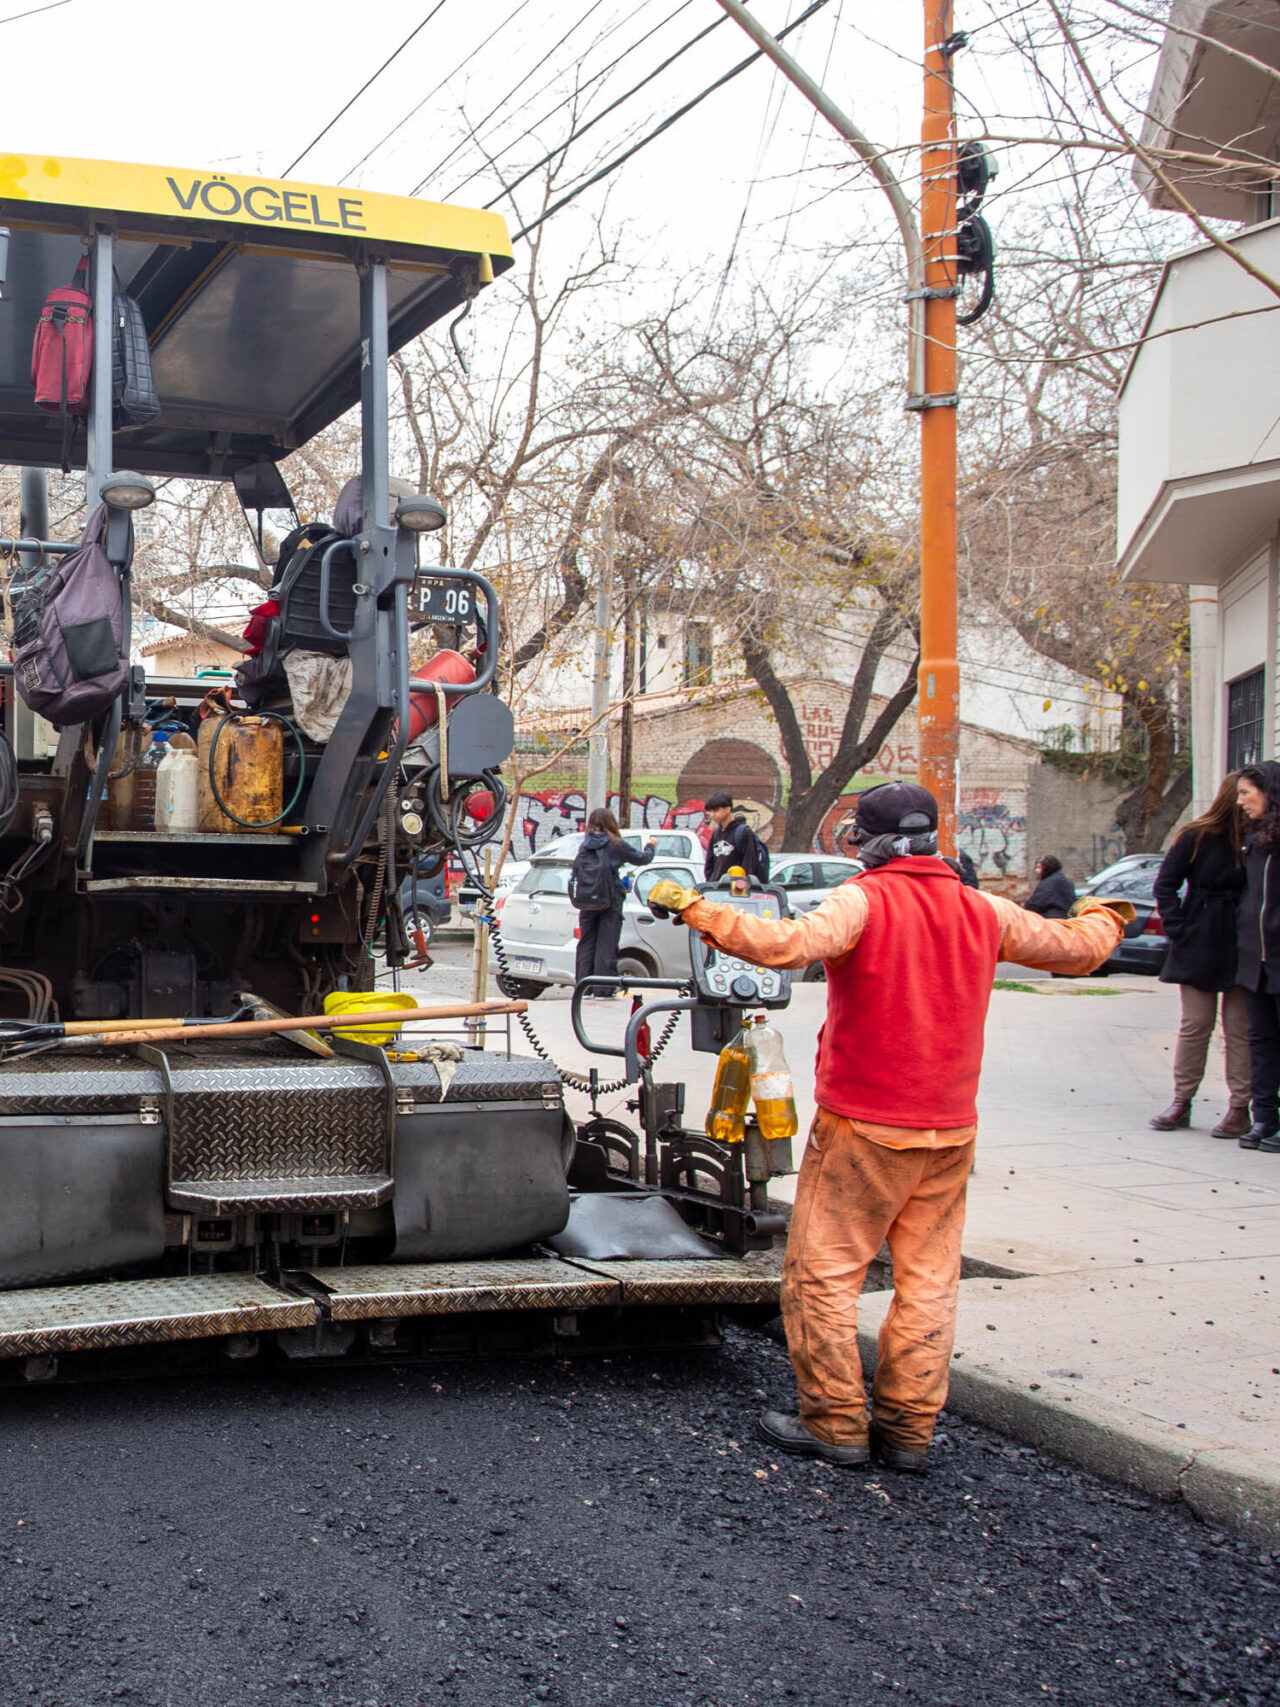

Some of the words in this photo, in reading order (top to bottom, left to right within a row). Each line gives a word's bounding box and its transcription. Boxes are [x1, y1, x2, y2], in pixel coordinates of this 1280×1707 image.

[166, 175, 367, 231] VÖGELE
[419, 587, 431, 612] P
[445, 589, 470, 615] 06
[802, 705, 833, 722] LAS
